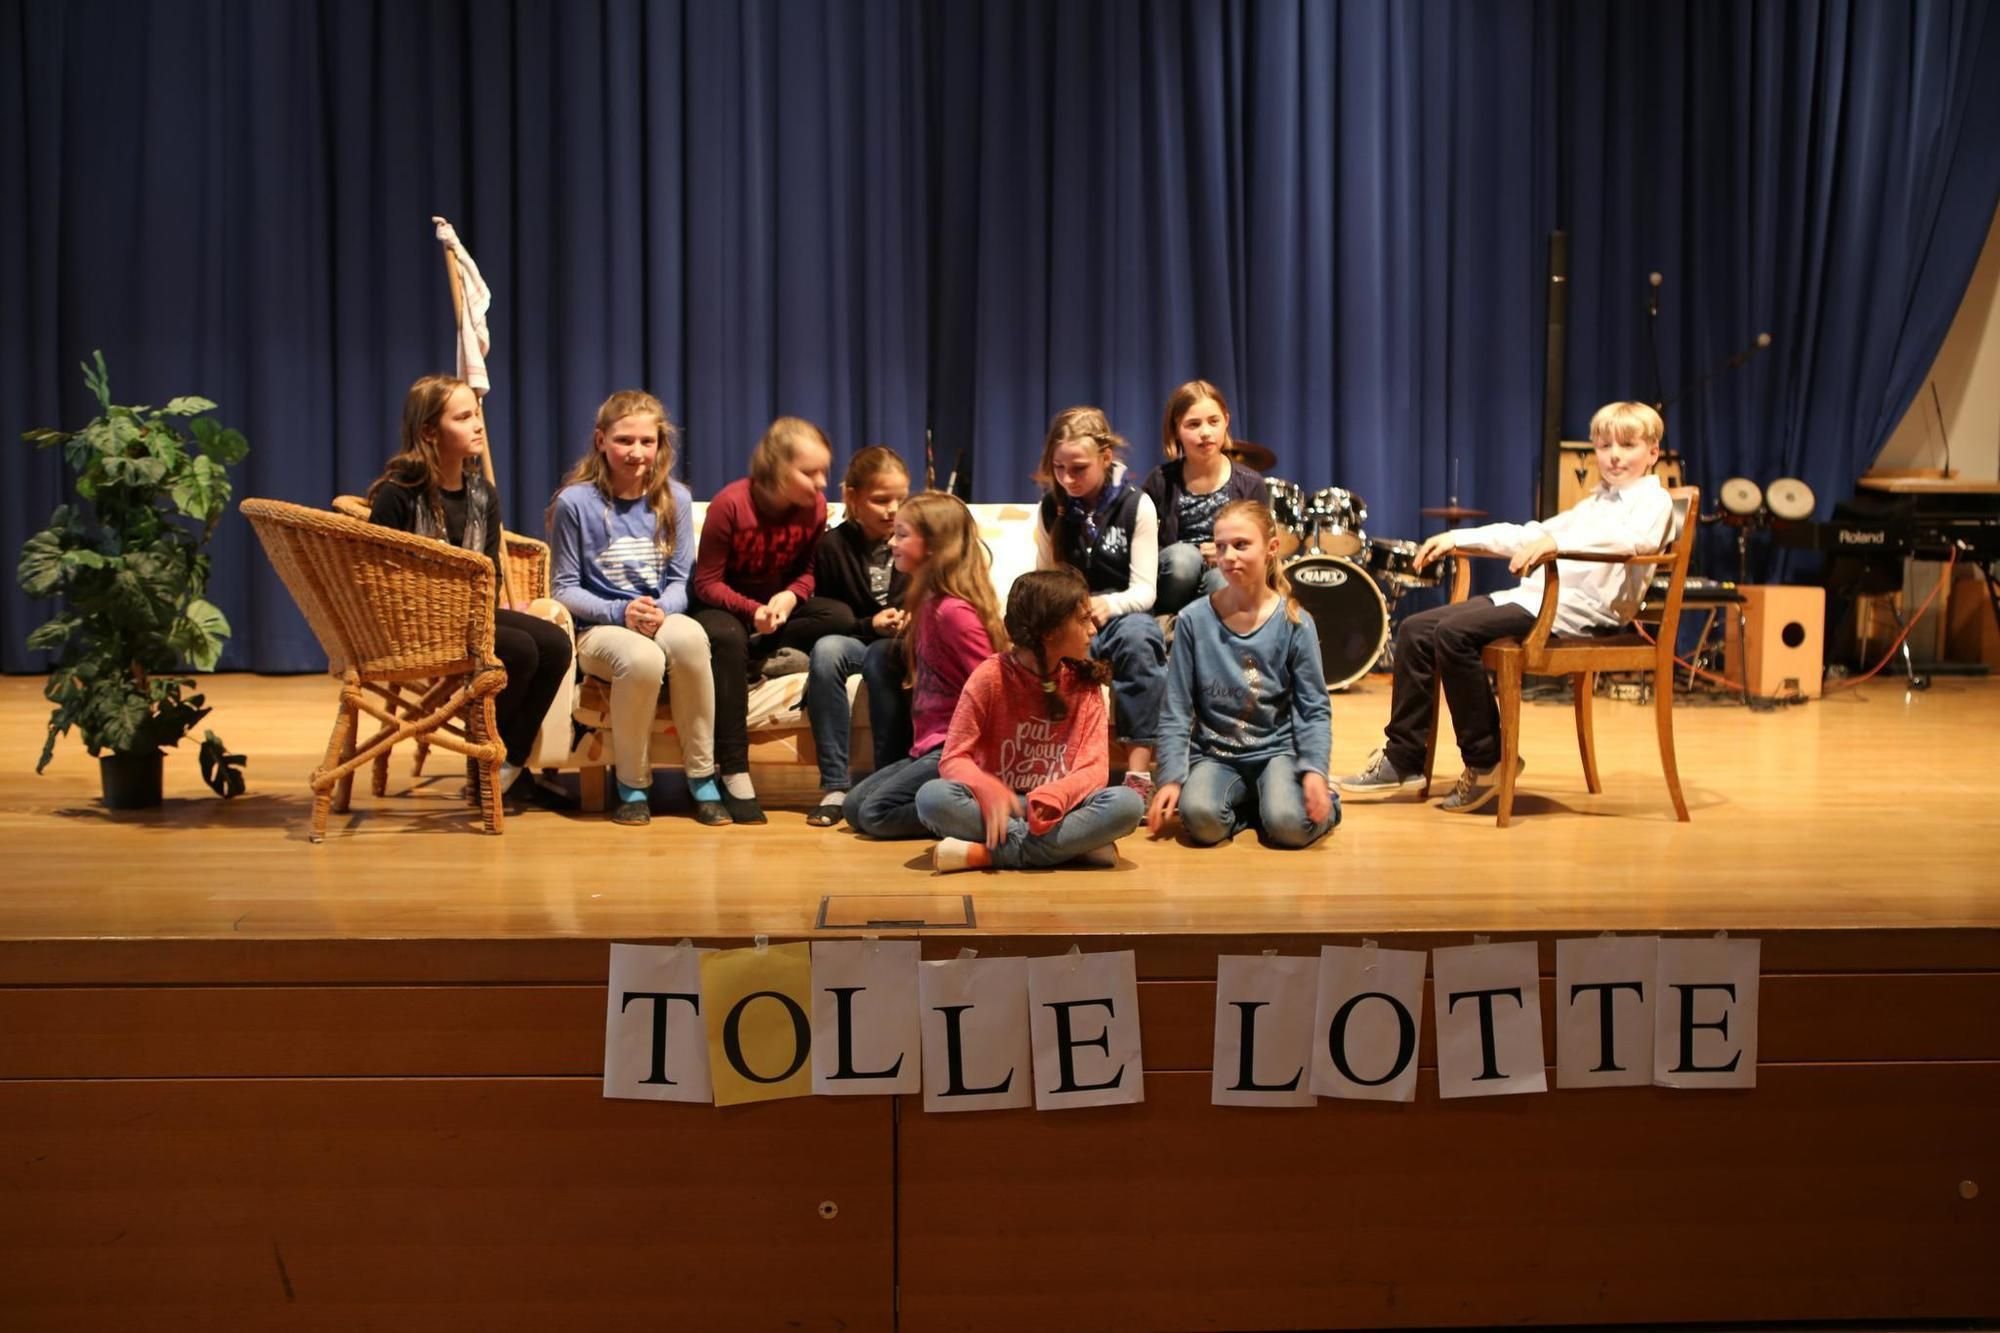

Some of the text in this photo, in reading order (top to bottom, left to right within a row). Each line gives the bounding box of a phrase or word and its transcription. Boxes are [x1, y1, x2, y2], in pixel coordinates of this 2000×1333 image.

[1839, 530, 1885, 544] Roland
[1016, 715, 1065, 750] put
[621, 981, 1742, 1097] TOLLE LOTTE
